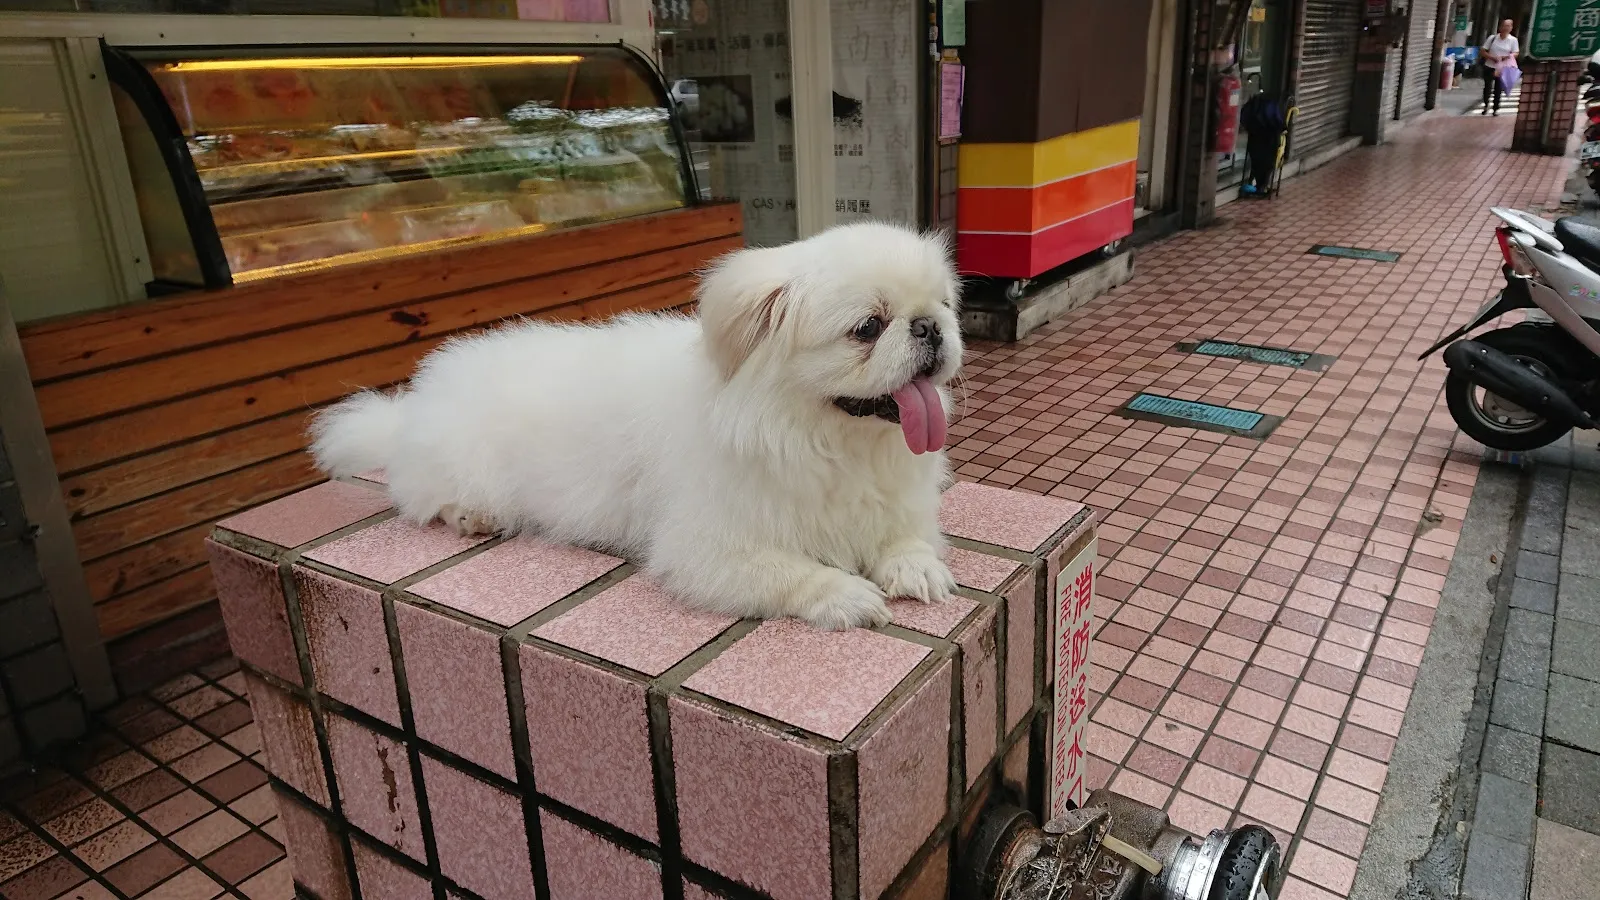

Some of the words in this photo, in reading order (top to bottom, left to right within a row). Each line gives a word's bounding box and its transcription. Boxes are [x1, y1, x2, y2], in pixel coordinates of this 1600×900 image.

[1060, 584, 1072, 627] FIRE
[1057, 627, 1070, 735] PROTECTION
[1055, 734, 1066, 793] WATER
